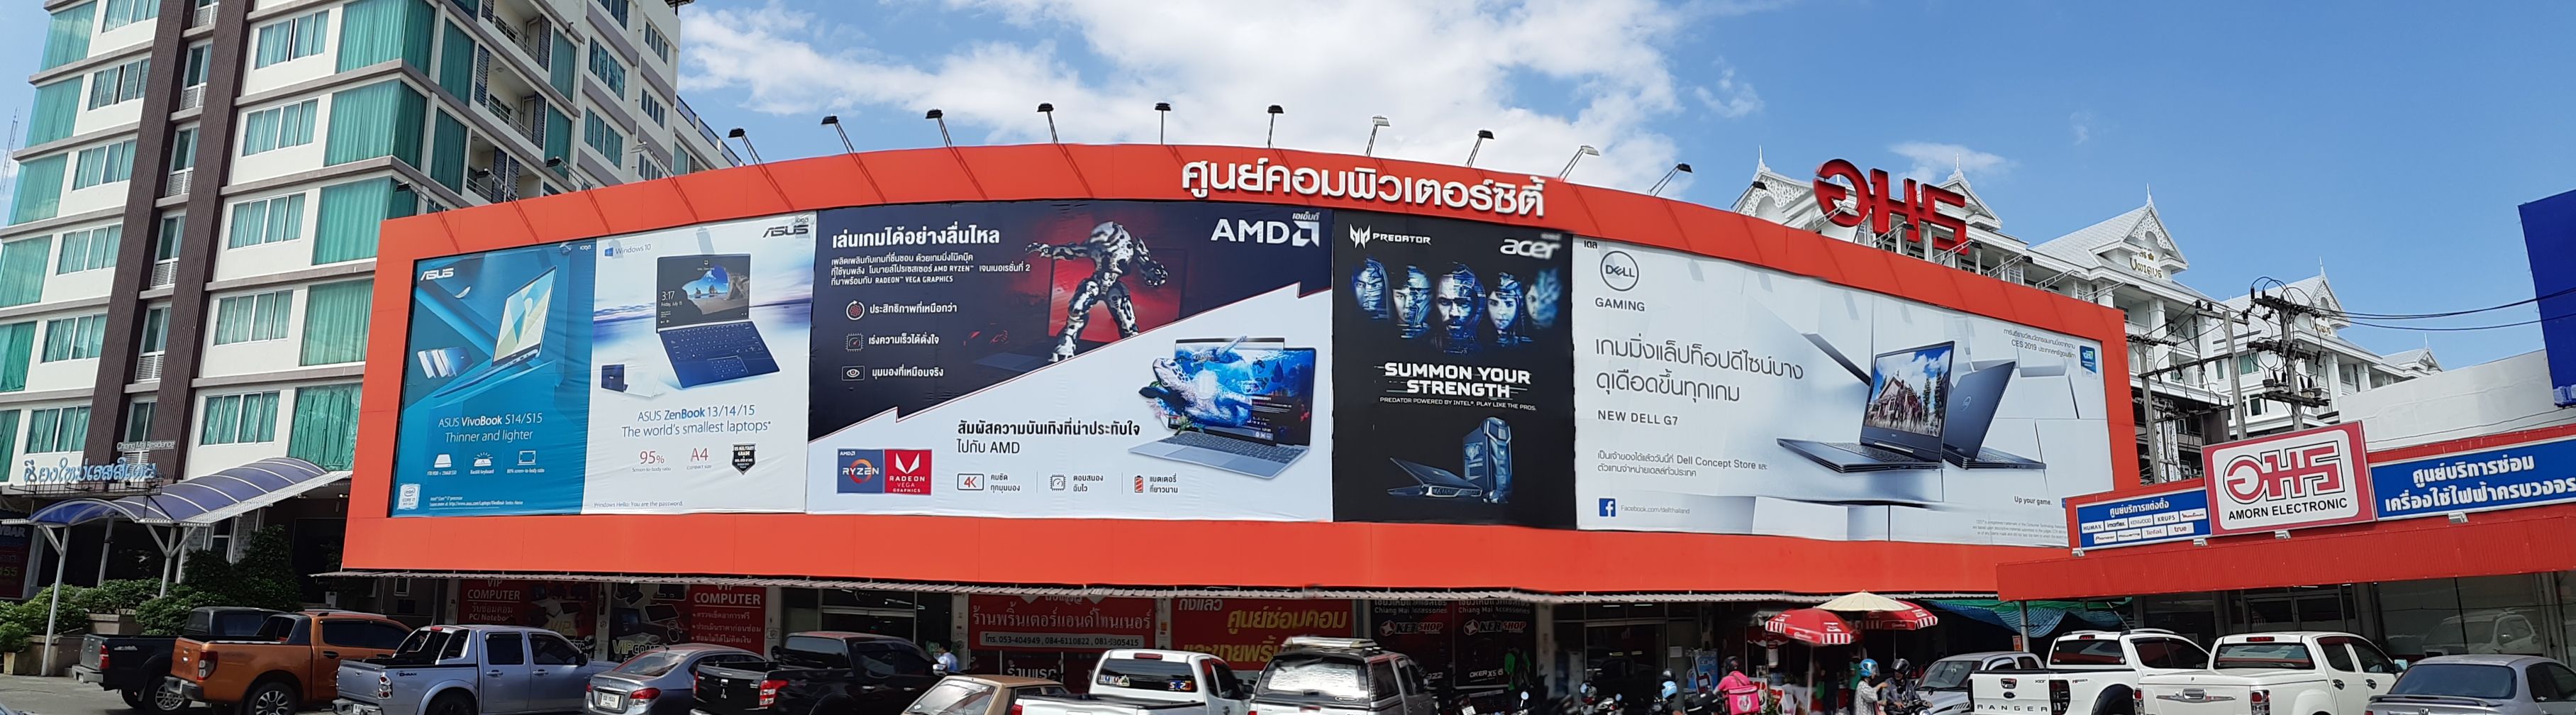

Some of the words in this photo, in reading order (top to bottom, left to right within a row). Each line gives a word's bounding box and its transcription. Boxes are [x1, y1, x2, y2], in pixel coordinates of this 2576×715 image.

[1182, 157, 1545, 217] ศูนย์คอมพิวเตอร์ซิตี้
[762, 225, 809, 238] ASUS
[832, 221, 1000, 248] เล่นเกมได้อย่างลื่นไหล
[1210, 219, 1290, 245] AMD
[1372, 232, 1432, 245] PREDATOR
[615, 245, 644, 255] Windows
[1499, 238, 1560, 260] acer
[420, 267, 454, 281] ASUS
[1605, 265, 1636, 277] DELL
[661, 291, 674, 301] 3:17
[870, 301, 957, 314] ประสิทธิภาพที่เหนือกว่า
[1595, 297, 1645, 311] GAMING
[2011, 339, 2023, 348] CES
[2024, 342, 2037, 350] 2019
[1596, 333, 1804, 379] เกมมิ่งแล็ปท็อปดีไซน์บาง
[872, 364, 943, 379] มุมมองที่เหมือนจริง
[1384, 362, 1472, 380] SUMMON
[1477, 367, 1531, 384] YOUR
[1406, 379, 1510, 398] STRENGTH
[1596, 369, 1740, 403] ดุเดือดขึ้นทุกเกม
[438, 417, 460, 428] ASUS
[462, 415, 502, 426] VivoBook
[505, 412, 543, 424] S14/S15
[638, 411, 662, 422] ASUS
[664, 407, 705, 421] ZenBook
[708, 404, 755, 416] 13/14/15
[1597, 410, 1626, 421] NEW
[1631, 413, 1660, 425] DELL
[1664, 416, 1678, 426] G7
[622, 426, 640, 438] The
[643, 424, 680, 437] world's
[682, 421, 723, 435] smallest
[957, 418, 1140, 436] สัมผัสความบันเทิงที่น่าประทับใจ
[445, 432, 479, 443] Thinner
[482, 431, 500, 441] and
[503, 429, 533, 443] lighter
[957, 438, 986, 453] ไปกับ
[990, 442, 1021, 454] AMD
[640, 450, 665, 465] 95%
[690, 448, 709, 462] A4
[1677, 455, 1693, 465] Dell
[1695, 457, 1731, 470] Concept
[1733, 460, 1755, 469] Store
[2414, 455, 2535, 488] ศูนย์บริการซ่อม
[963, 476, 977, 488] 4K
[2228, 508, 2268, 521] AMORN
[2272, 499, 2348, 516] ELECTRONIC
[467, 589, 521, 600] COMPUTER
[694, 592, 761, 605] COMPUTER
[972, 602, 1152, 629] ร้านพริ้นเตอร์แอนด์โทนเนอร์
[1375, 606, 1397, 615] Chiang
[1458, 606, 1480, 615] Chiang
[1227, 606, 1348, 634] ศูนย์ซ่อมคอม
[1419, 621, 1443, 631] SHOP
[1502, 621, 1526, 631] SHOP
